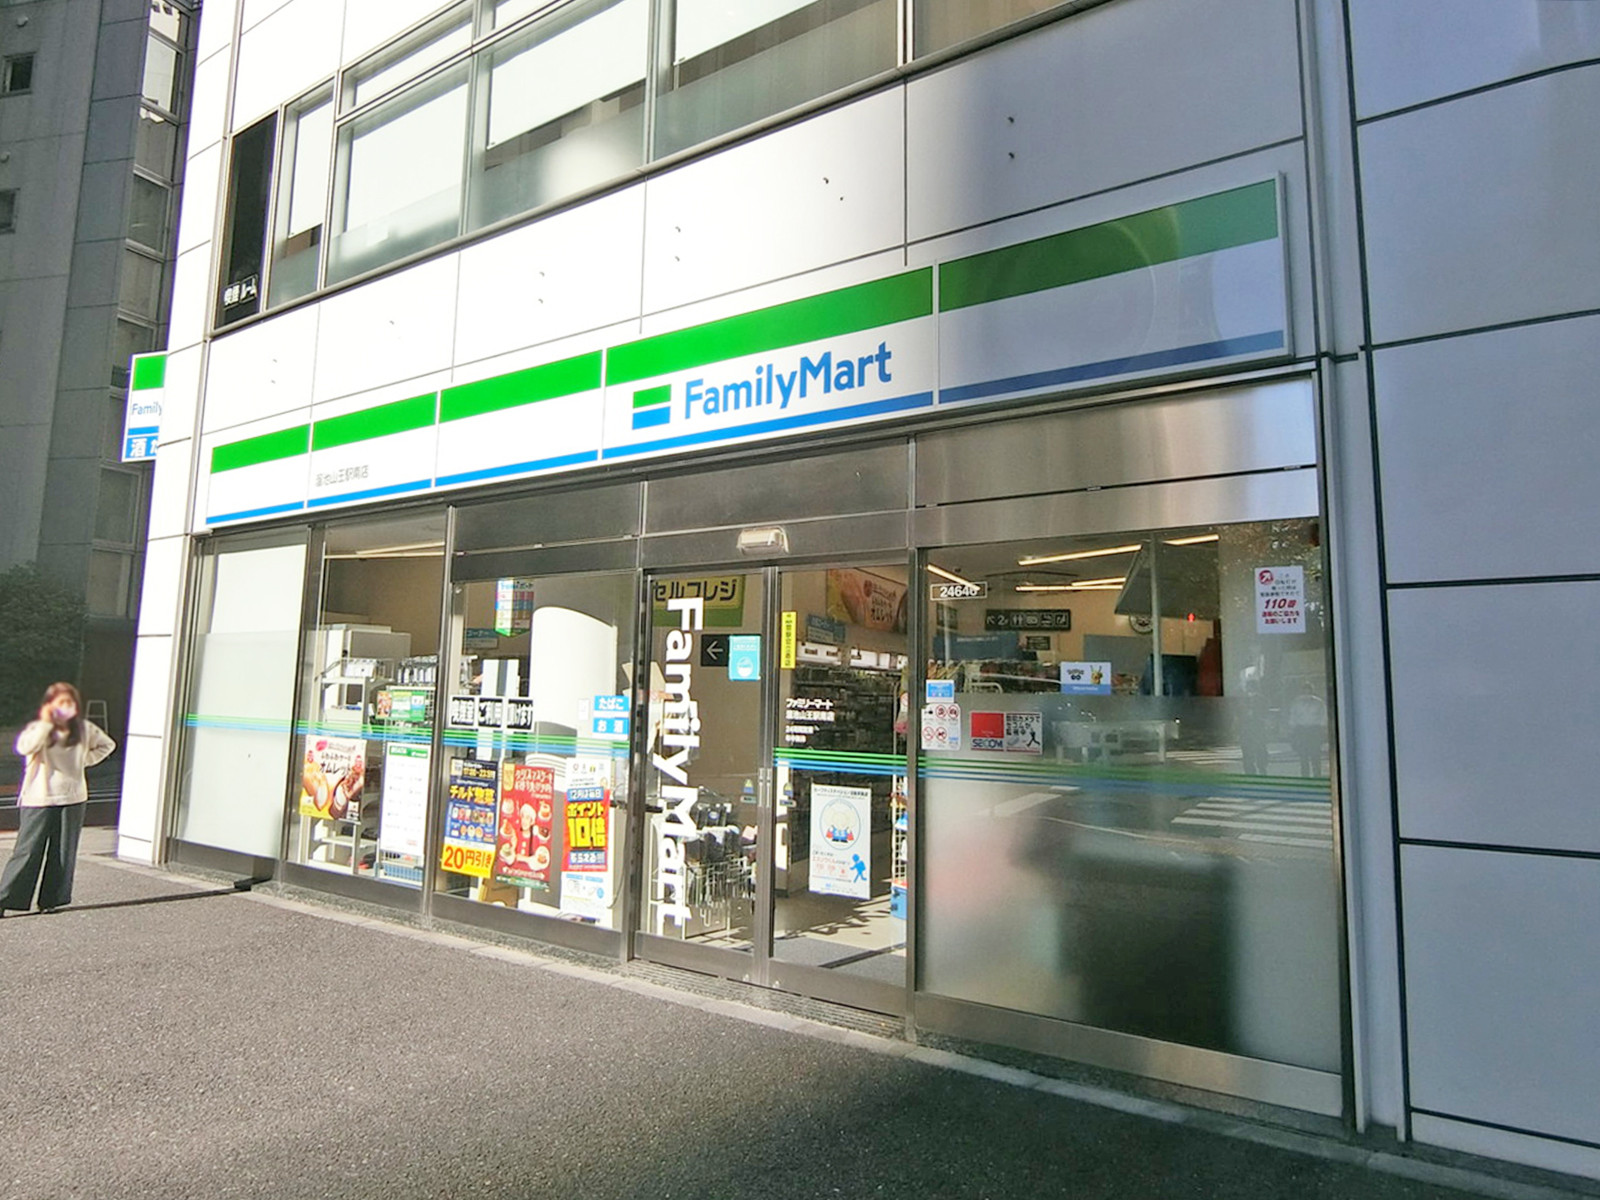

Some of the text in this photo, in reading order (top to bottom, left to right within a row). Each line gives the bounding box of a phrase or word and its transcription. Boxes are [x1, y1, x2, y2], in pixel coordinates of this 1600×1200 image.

[684, 341, 892, 420] FamilyMart
[654, 580, 737, 601] セルフレジ
[597, 697, 625, 710] たばこ
[972, 738, 1003, 748] SECOM
[653, 597, 704, 927] FamilyMart
[567, 802, 605, 817] ポイント
[567, 816, 606, 848] 10倍
[443, 845, 492, 869] 20円引き
